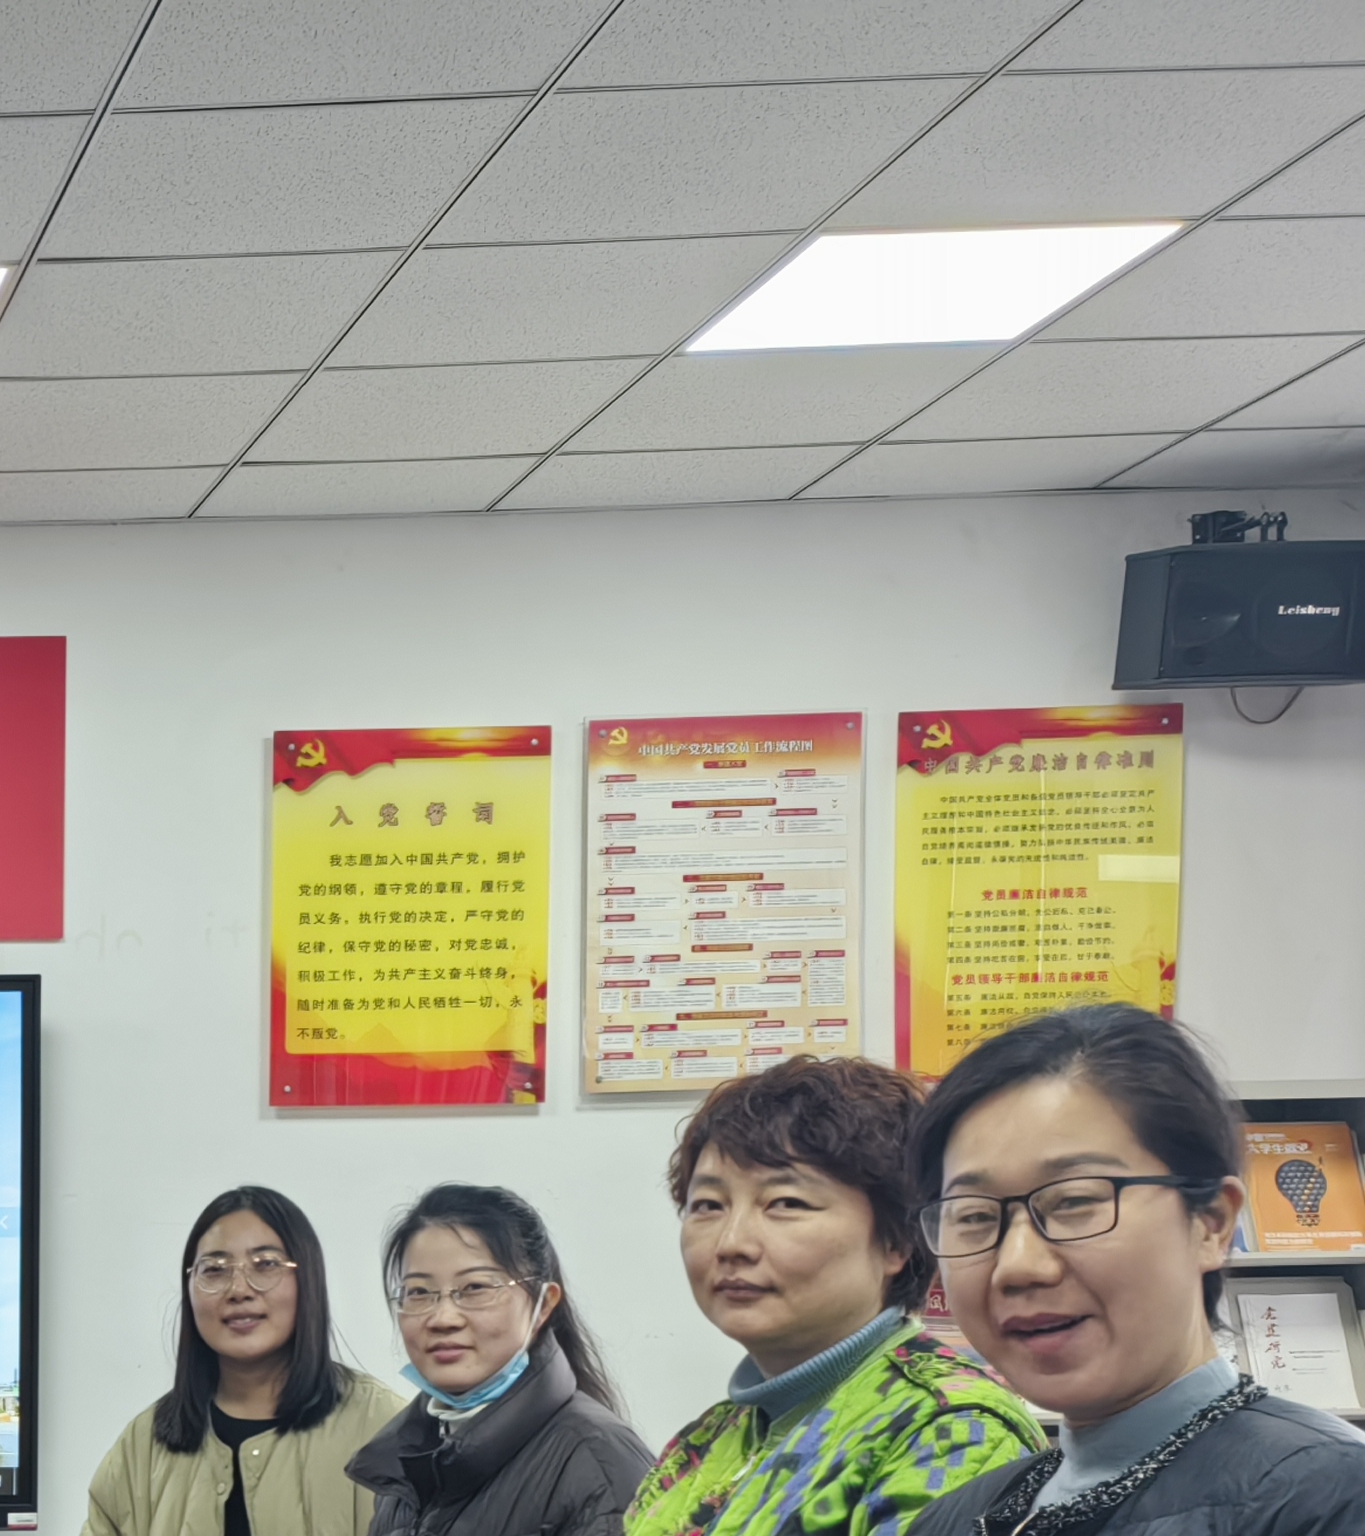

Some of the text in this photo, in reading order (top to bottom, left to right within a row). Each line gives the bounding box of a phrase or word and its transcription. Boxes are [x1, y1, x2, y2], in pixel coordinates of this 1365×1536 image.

[1278, 604, 1340, 616] Leisheng
[923, 749, 1155, 775] 中国共产党廉洁自律准则
[329, 801, 496, 828] 入党誓词
